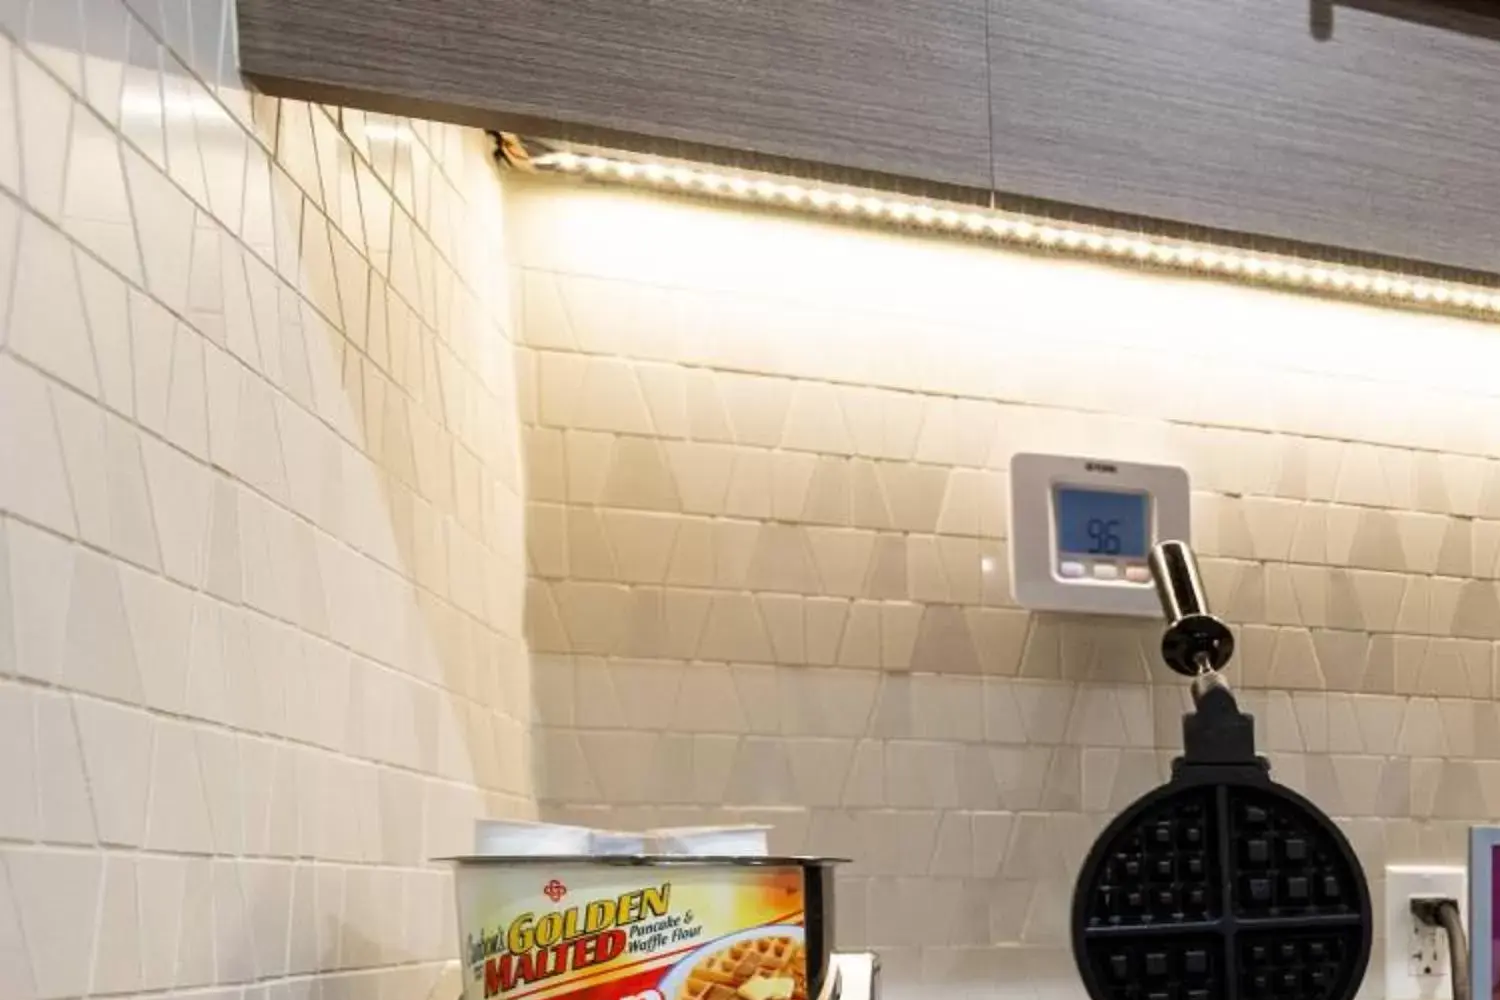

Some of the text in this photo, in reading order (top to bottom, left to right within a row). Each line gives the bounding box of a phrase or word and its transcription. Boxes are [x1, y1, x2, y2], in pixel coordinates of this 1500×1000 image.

[1086, 517, 1121, 555] 96
[507, 883, 671, 956] GOLDEN
[629, 908, 696, 938] Pancake &
[629, 925, 703, 954] Waffle Flour
[484, 929, 627, 999] MALTED
